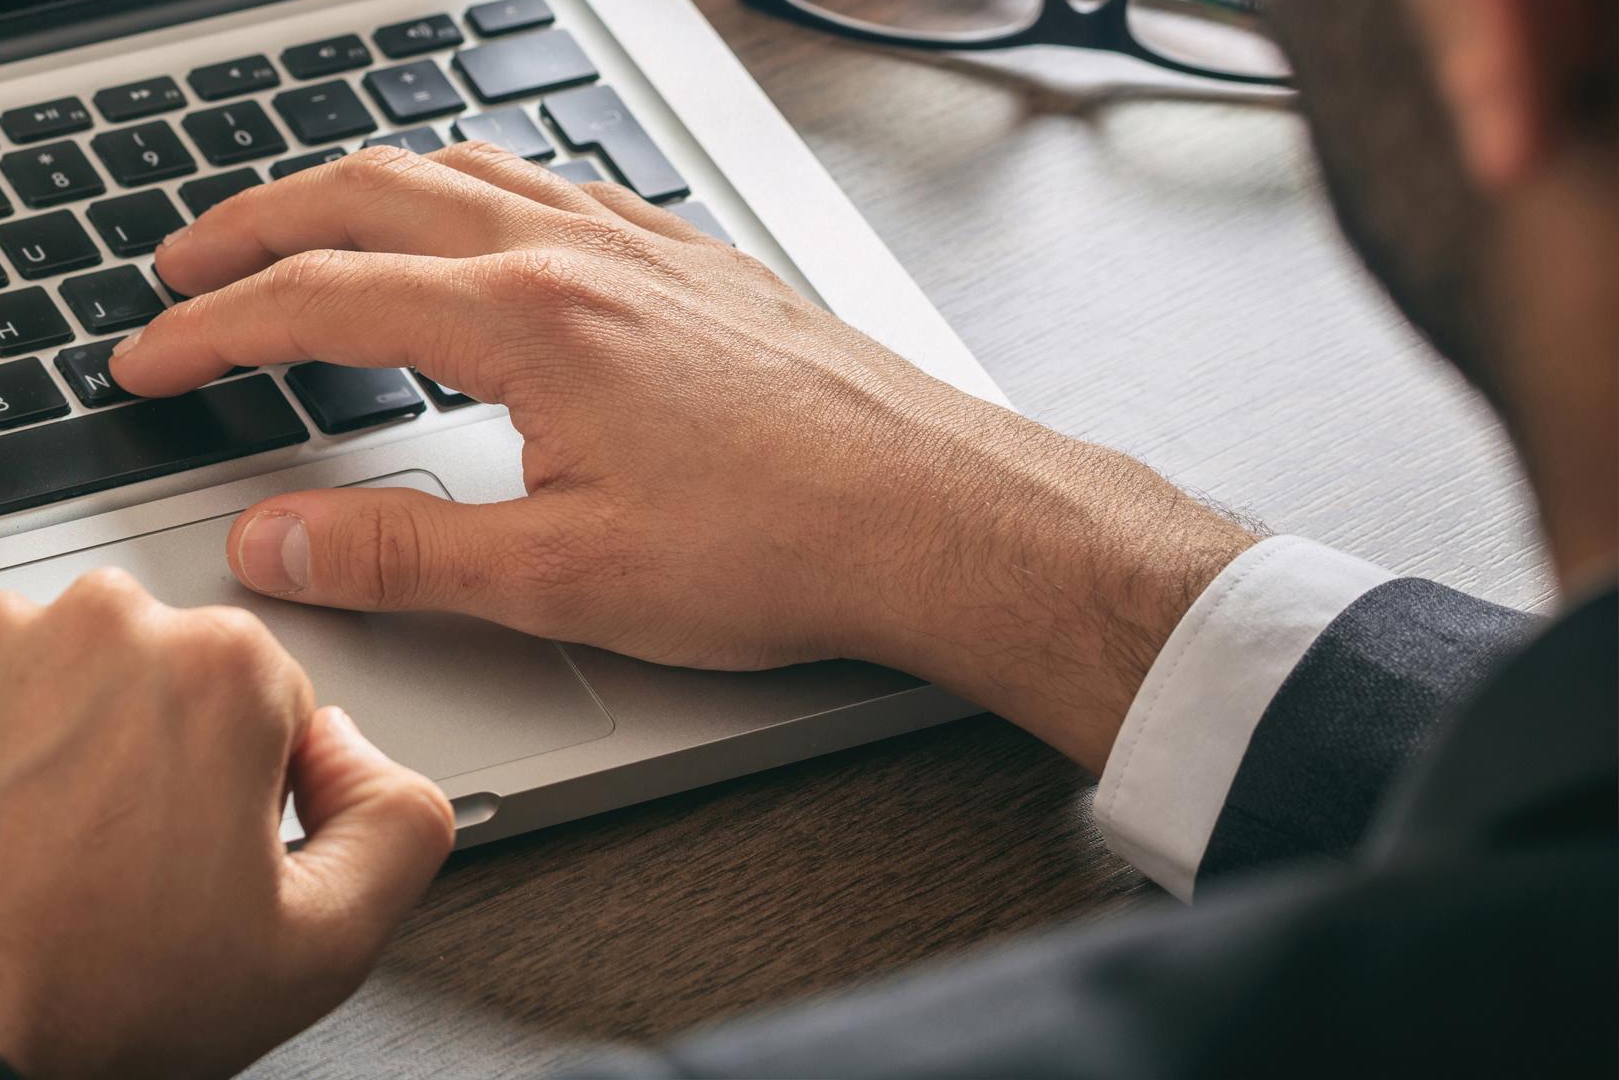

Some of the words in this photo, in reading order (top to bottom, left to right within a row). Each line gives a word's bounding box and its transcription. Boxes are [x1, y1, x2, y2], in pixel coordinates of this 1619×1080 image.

[142, 151, 159, 166] 9
[51, 172, 70, 188] 8
[22, 244, 46, 262] U
[94, 301, 106, 318] J
[84, 372, 109, 392] N
